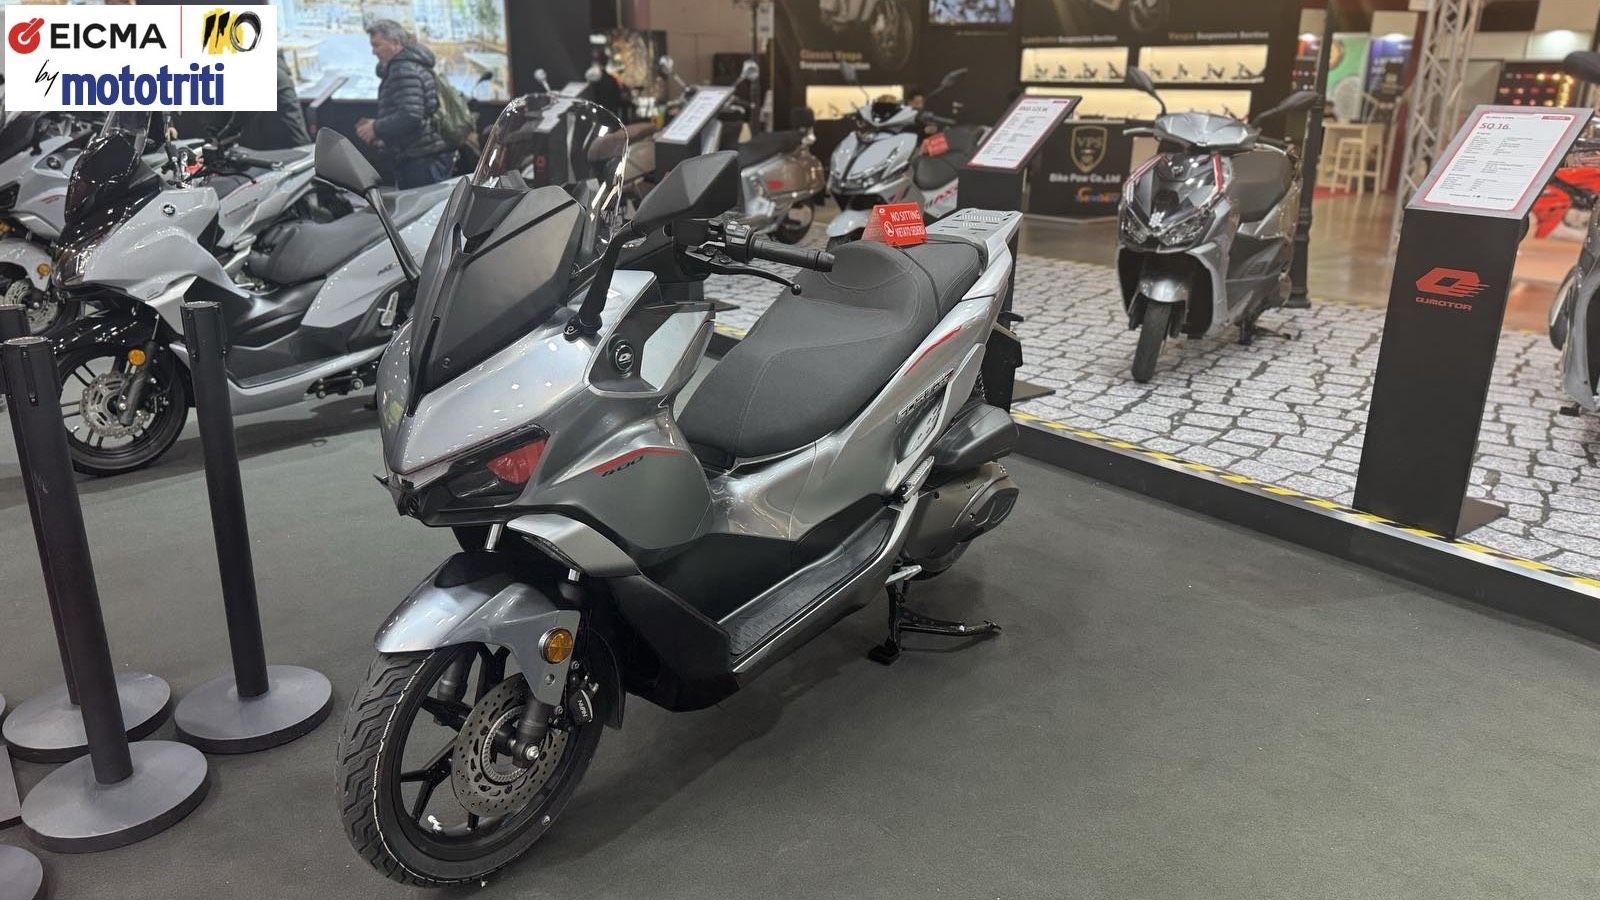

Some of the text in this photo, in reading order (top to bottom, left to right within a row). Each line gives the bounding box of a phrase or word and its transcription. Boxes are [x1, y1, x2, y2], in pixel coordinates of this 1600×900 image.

[1048, 172, 1069, 183] Bike
[890, 209, 921, 222] NO SITTING
[1415, 296, 1473, 311] QJMOTOR
[601, 455, 645, 477] 400
